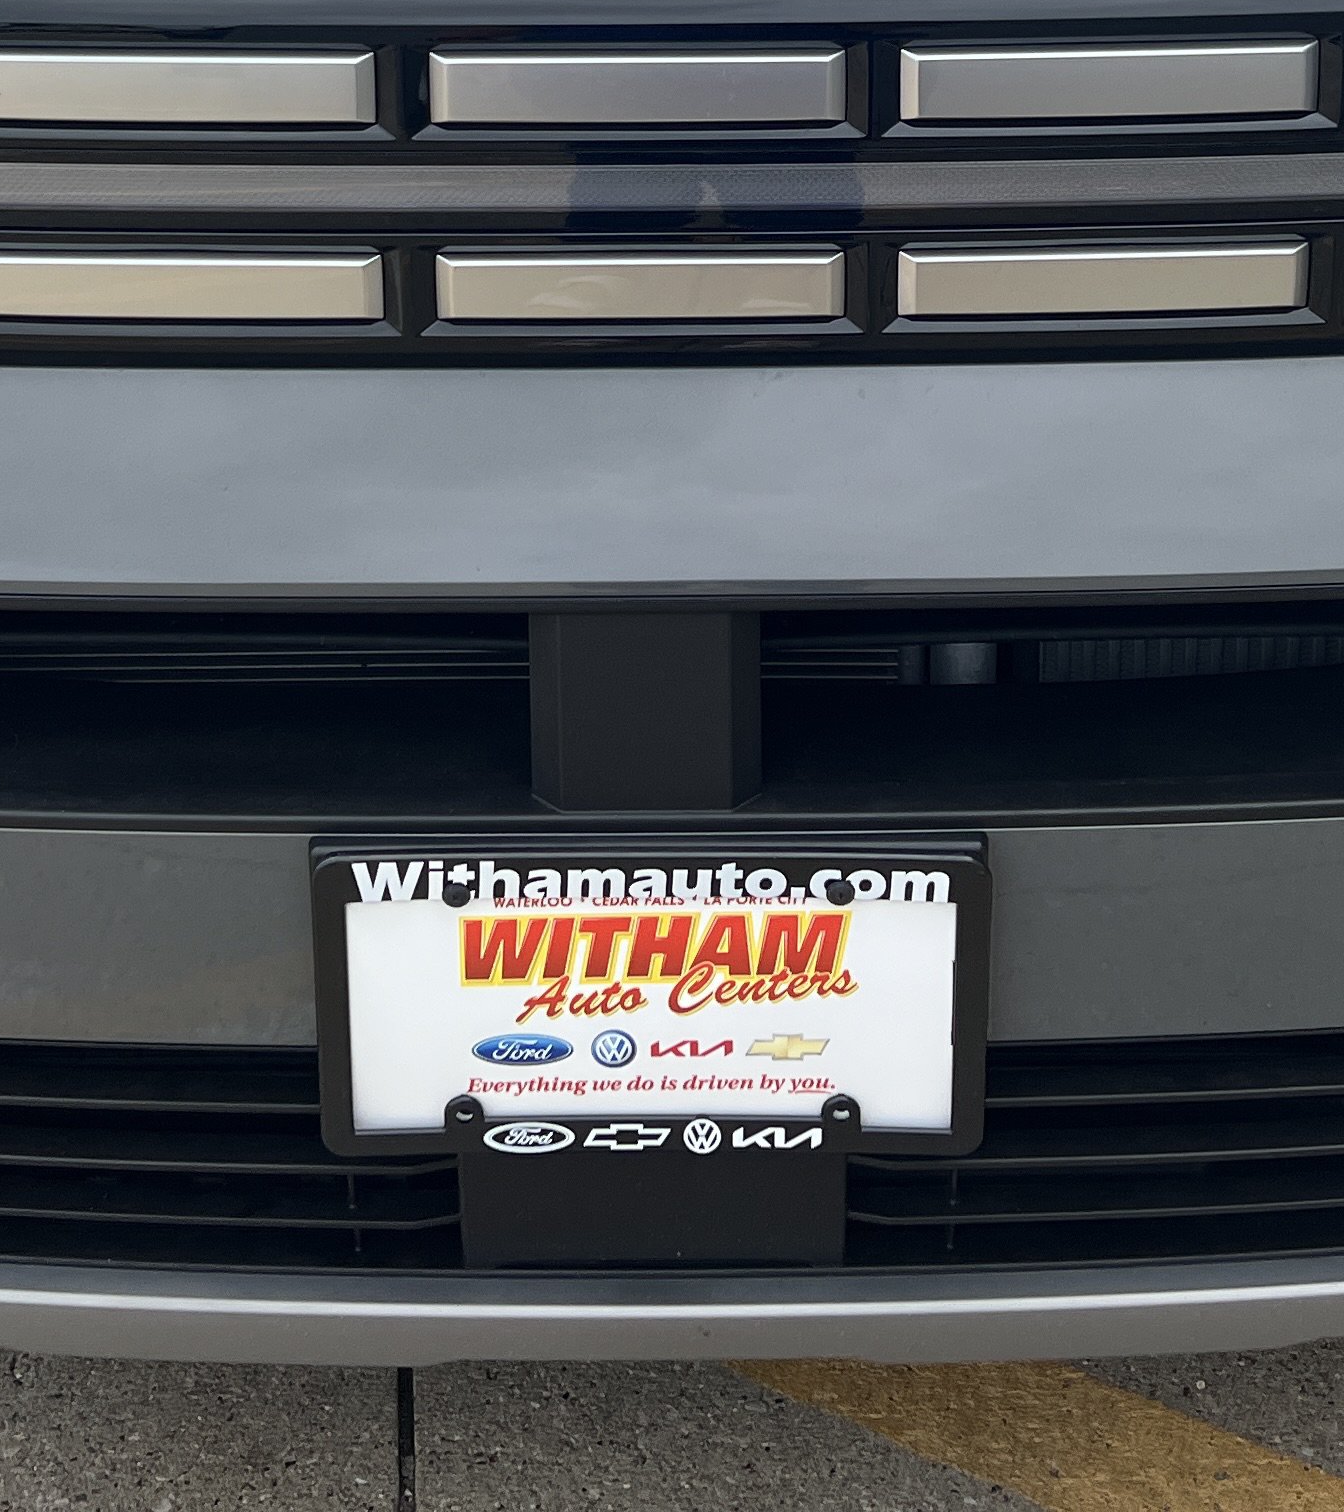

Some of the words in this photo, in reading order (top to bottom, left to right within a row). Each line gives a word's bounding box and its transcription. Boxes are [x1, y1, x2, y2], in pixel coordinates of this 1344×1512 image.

[351, 860, 950, 903] Withamauto.com
[459, 912, 854, 985] WITHAM
[515, 974, 648, 1025] Auto
[668, 960, 859, 1016] Centers
[467, 1076, 588, 1096] Everything
[592, 1080, 622, 1092] we
[627, 1075, 654, 1091] do
[660, 1075, 678, 1091] is
[682, 1074, 754, 1091] driven
[759, 1074, 786, 1094] by
[787, 1077, 836, 1094] you.
